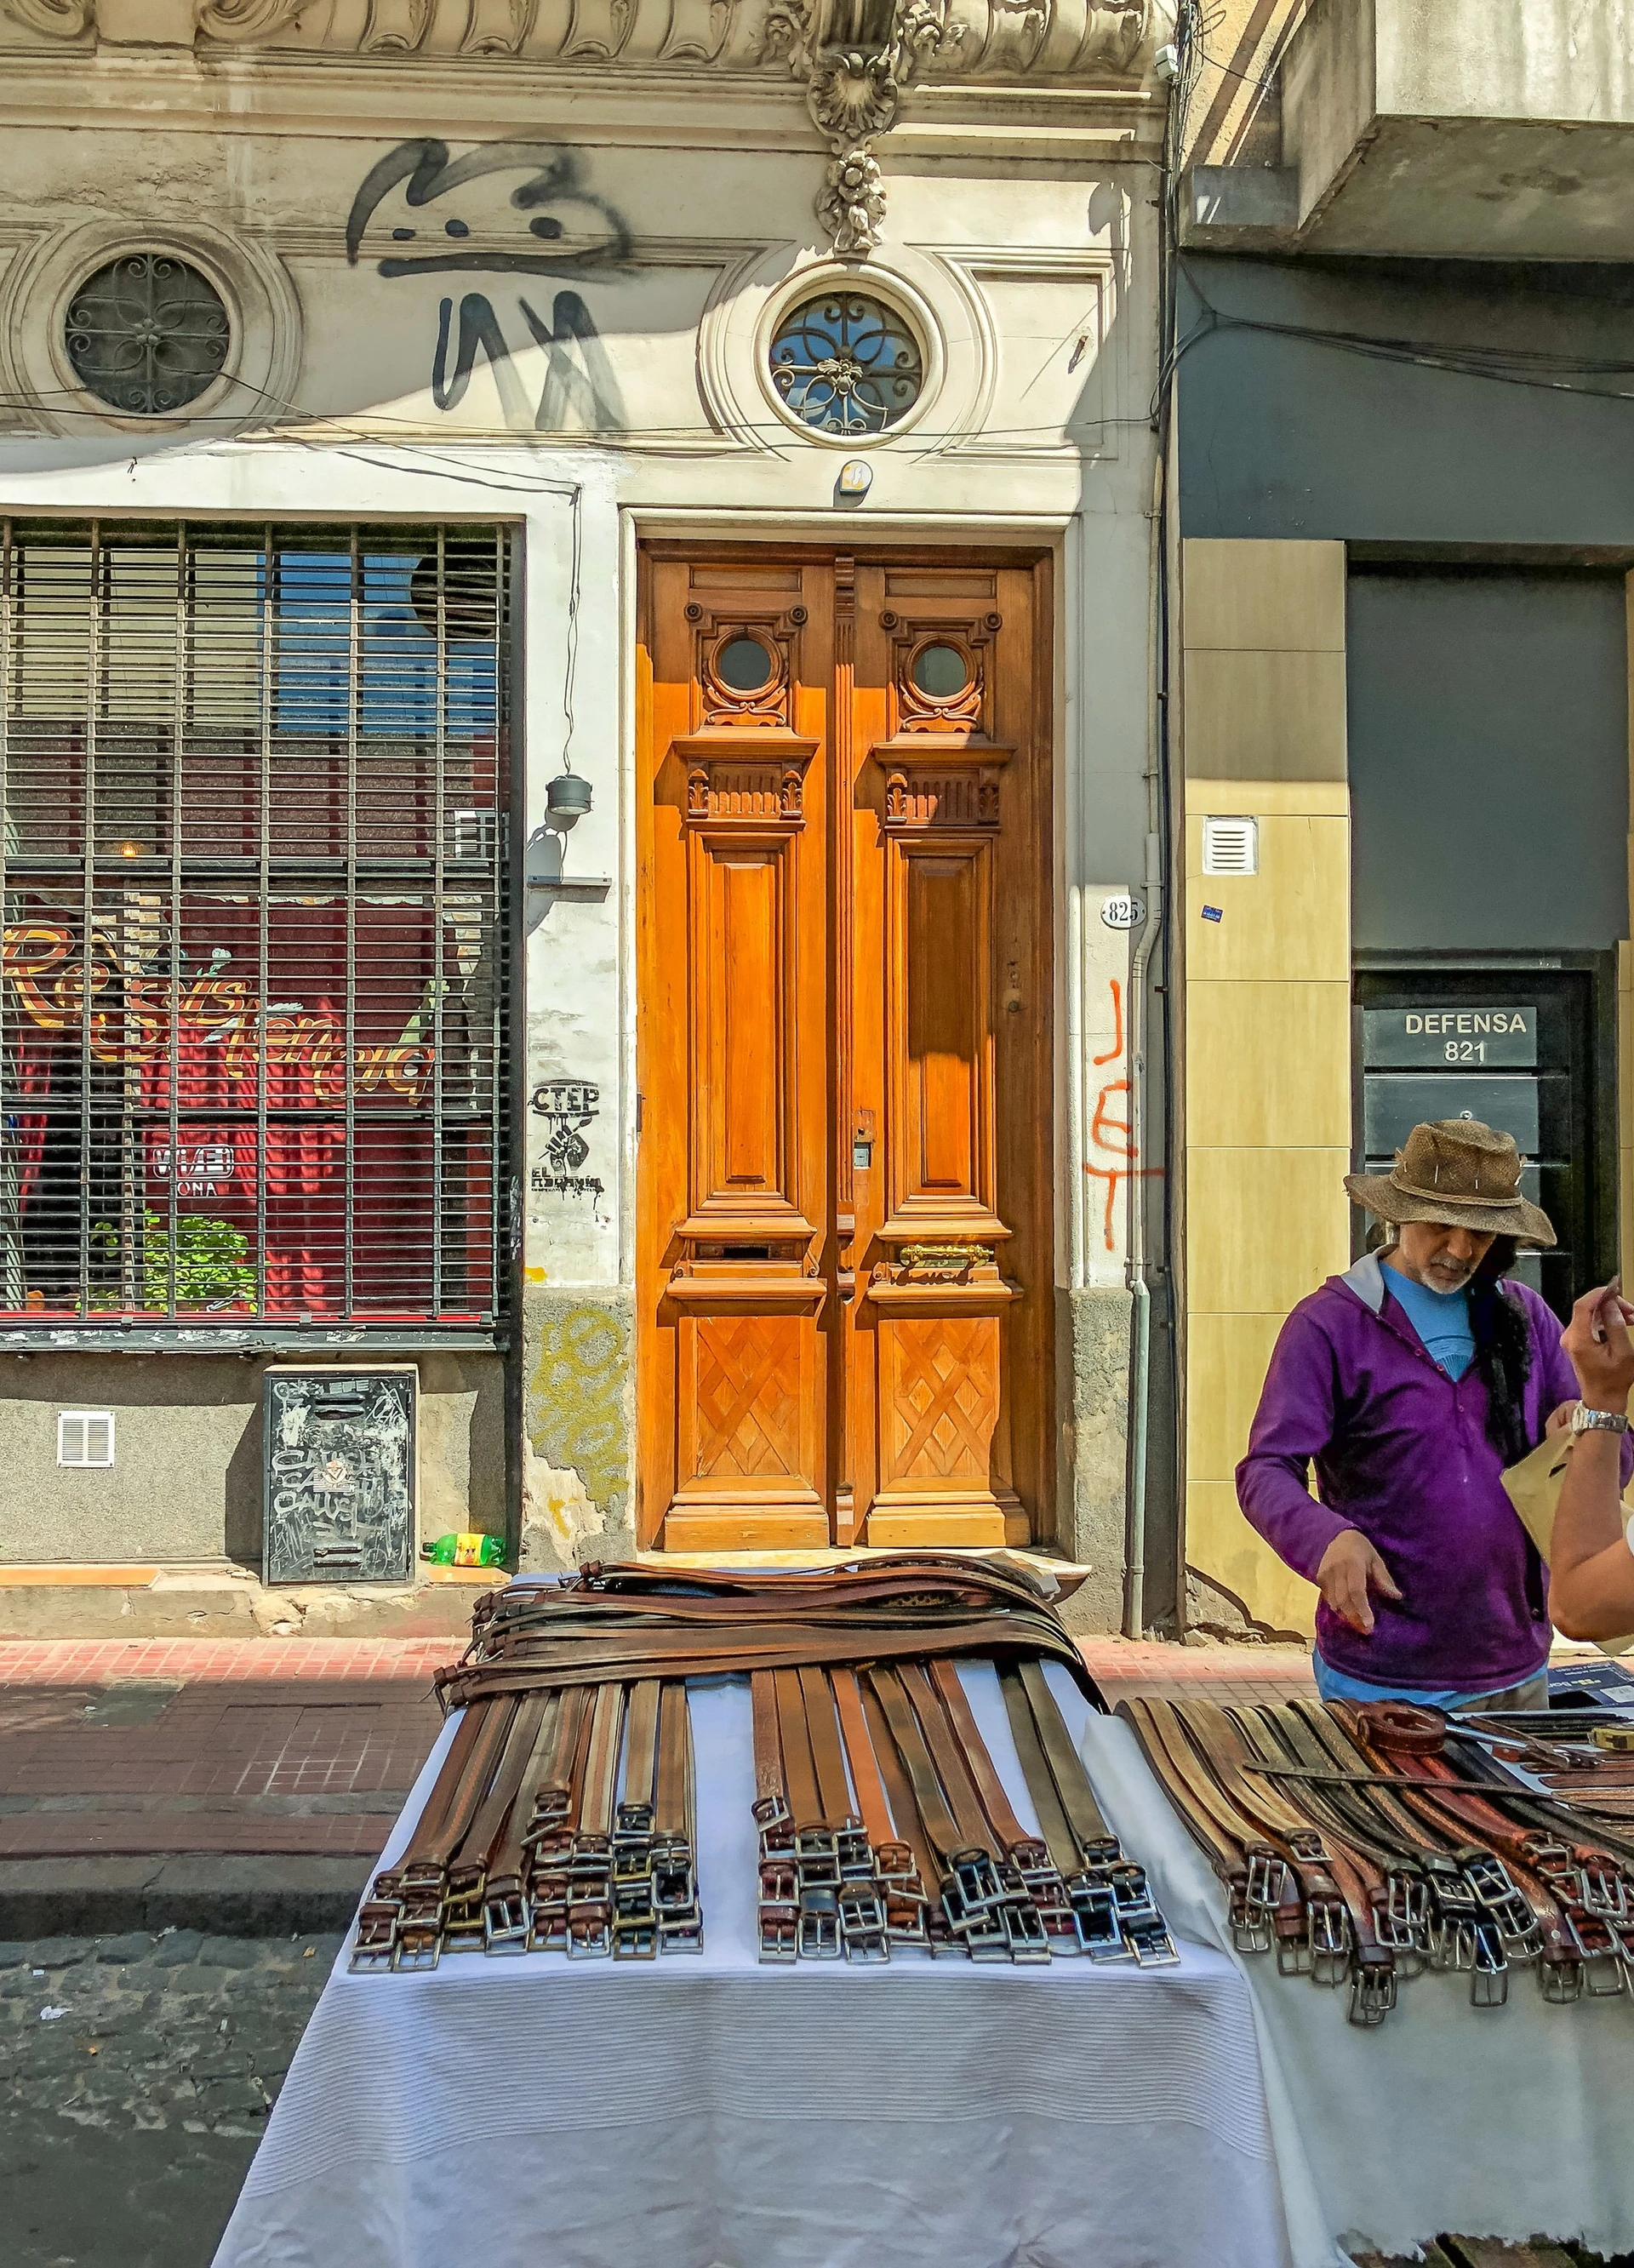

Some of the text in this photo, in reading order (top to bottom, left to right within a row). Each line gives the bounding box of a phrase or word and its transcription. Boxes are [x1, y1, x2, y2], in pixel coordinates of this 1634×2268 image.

[1109, 901, 1139, 922] 825
[1405, 1013, 1528, 1034] DEFENSA
[1444, 1040, 1486, 1062] 821
[533, 1087, 599, 1111] CTEP
[531, 1167, 551, 1177] EL
